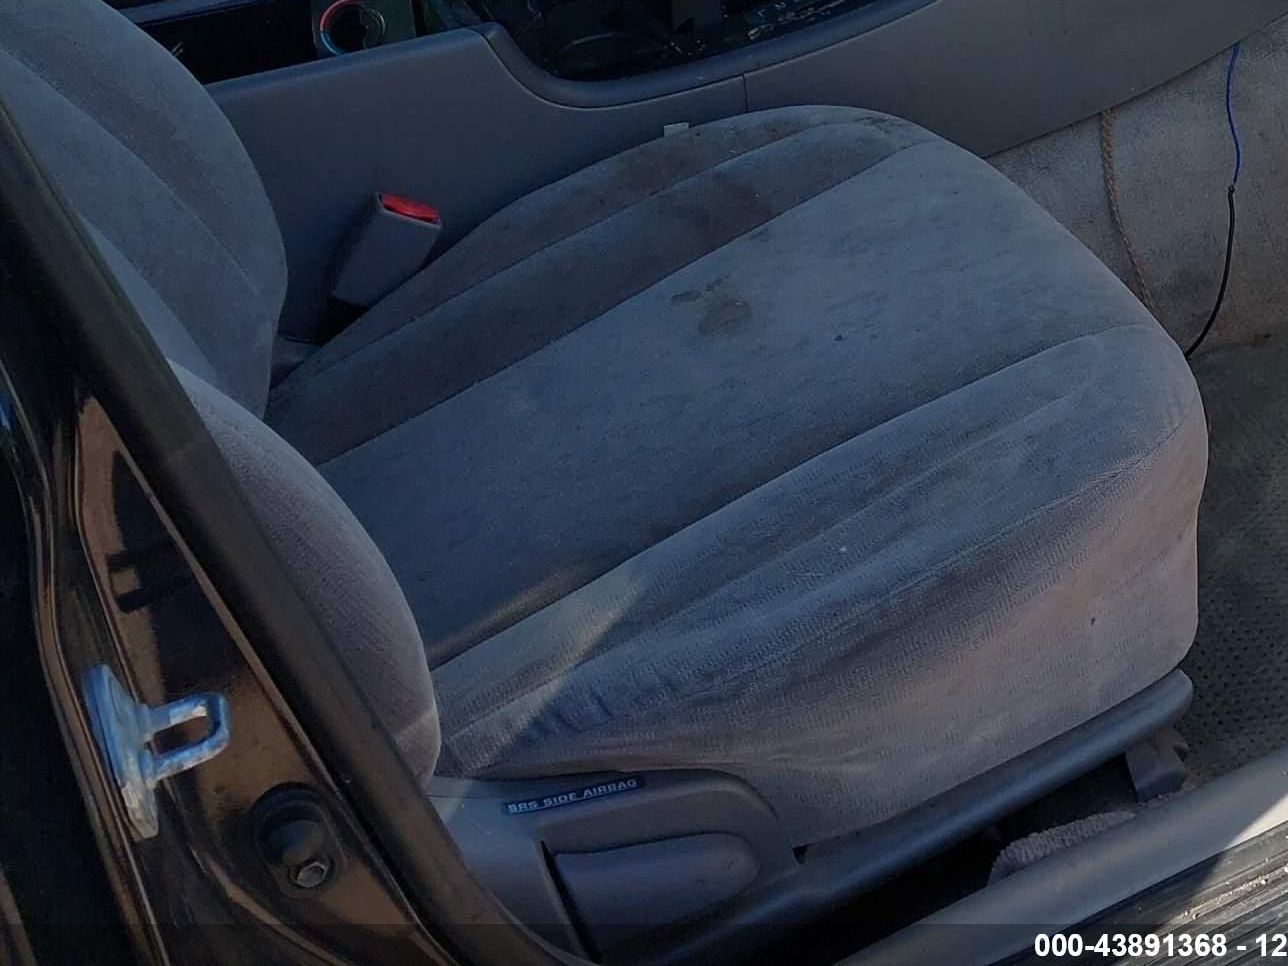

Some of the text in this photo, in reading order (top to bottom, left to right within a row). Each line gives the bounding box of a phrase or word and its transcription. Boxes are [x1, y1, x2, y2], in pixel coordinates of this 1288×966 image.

[508, 778, 638, 813] SRS SIDE AIRBAG
